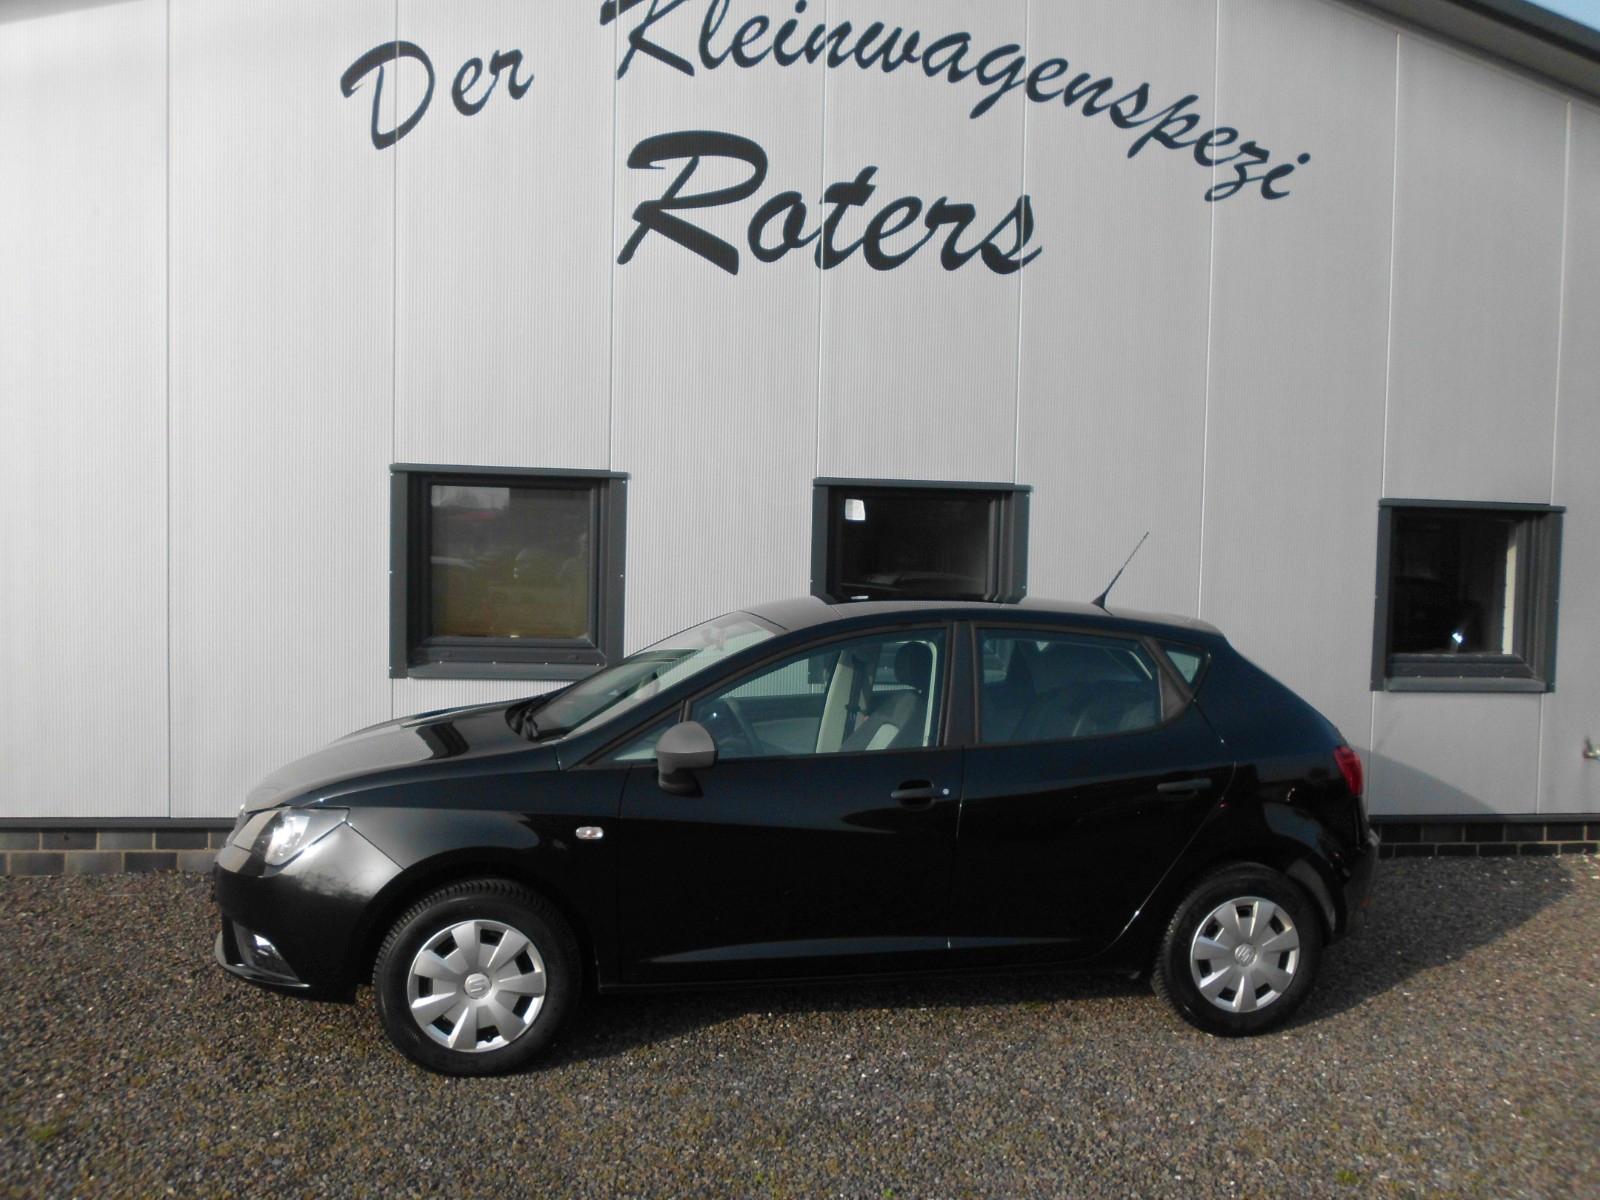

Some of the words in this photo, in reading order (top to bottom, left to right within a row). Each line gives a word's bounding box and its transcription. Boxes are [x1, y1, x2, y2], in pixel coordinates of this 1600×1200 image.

[341, 41, 533, 149] Der
[600, 0, 1310, 202] Kleinwagenspezi
[618, 130, 1043, 275] Roters
